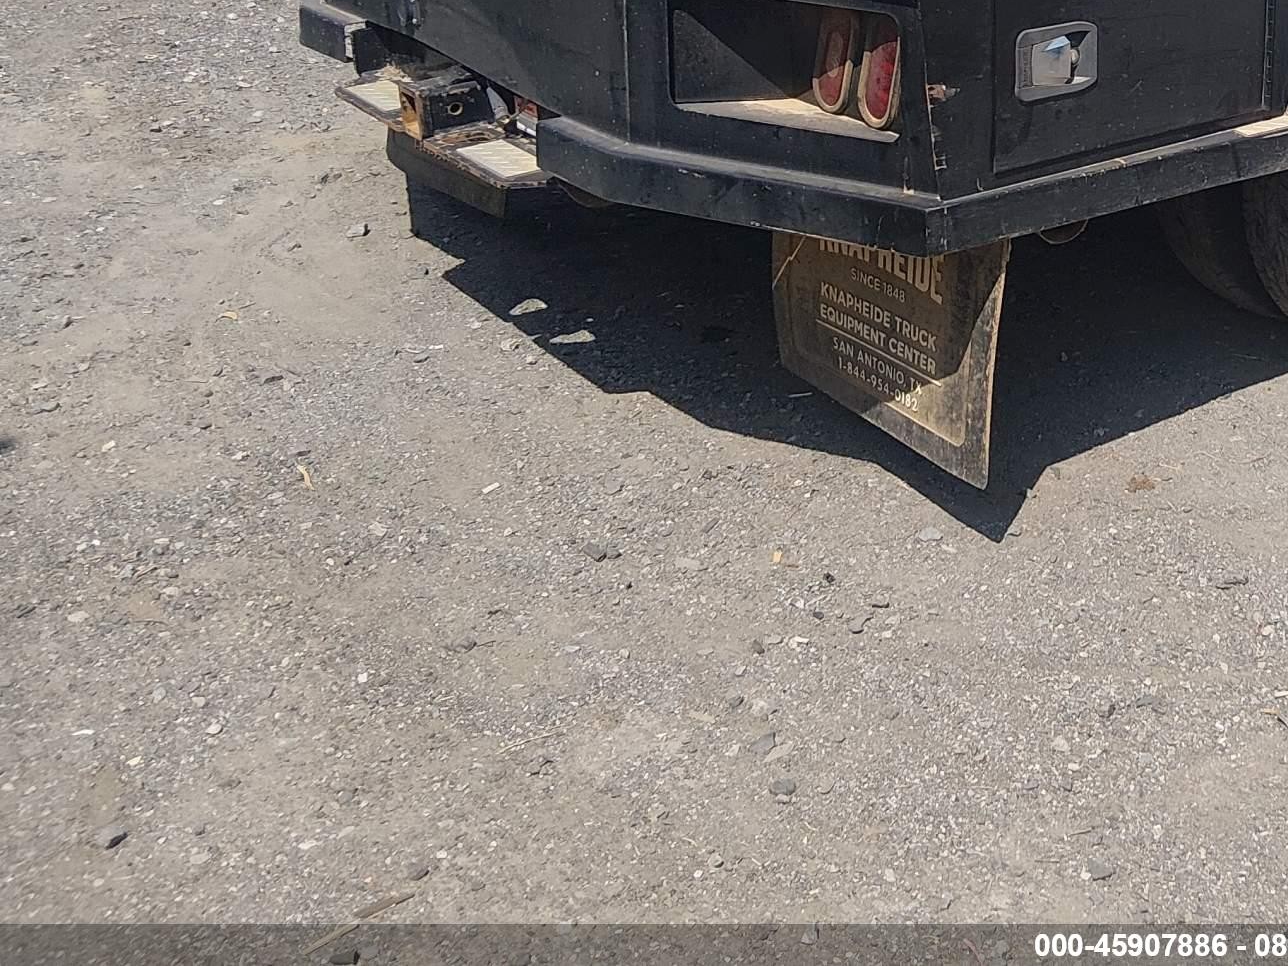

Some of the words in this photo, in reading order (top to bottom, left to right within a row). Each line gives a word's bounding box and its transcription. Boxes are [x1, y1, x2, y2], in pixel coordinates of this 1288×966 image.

[850, 267, 881, 291] SINCE
[882, 282, 906, 303] 1848
[819, 303, 887, 347] EQUIPMENT
[888, 337, 937, 375] CENTER
[820, 281, 891, 328] KNAPHEIDE
[894, 316, 938, 352] TRUCK
[833, 337, 854, 358] SAN
[857, 349, 907, 387] ANTONIO,
[909, 376, 922, 395] TX
[838, 356, 919, 412] 1-844-954-0182
